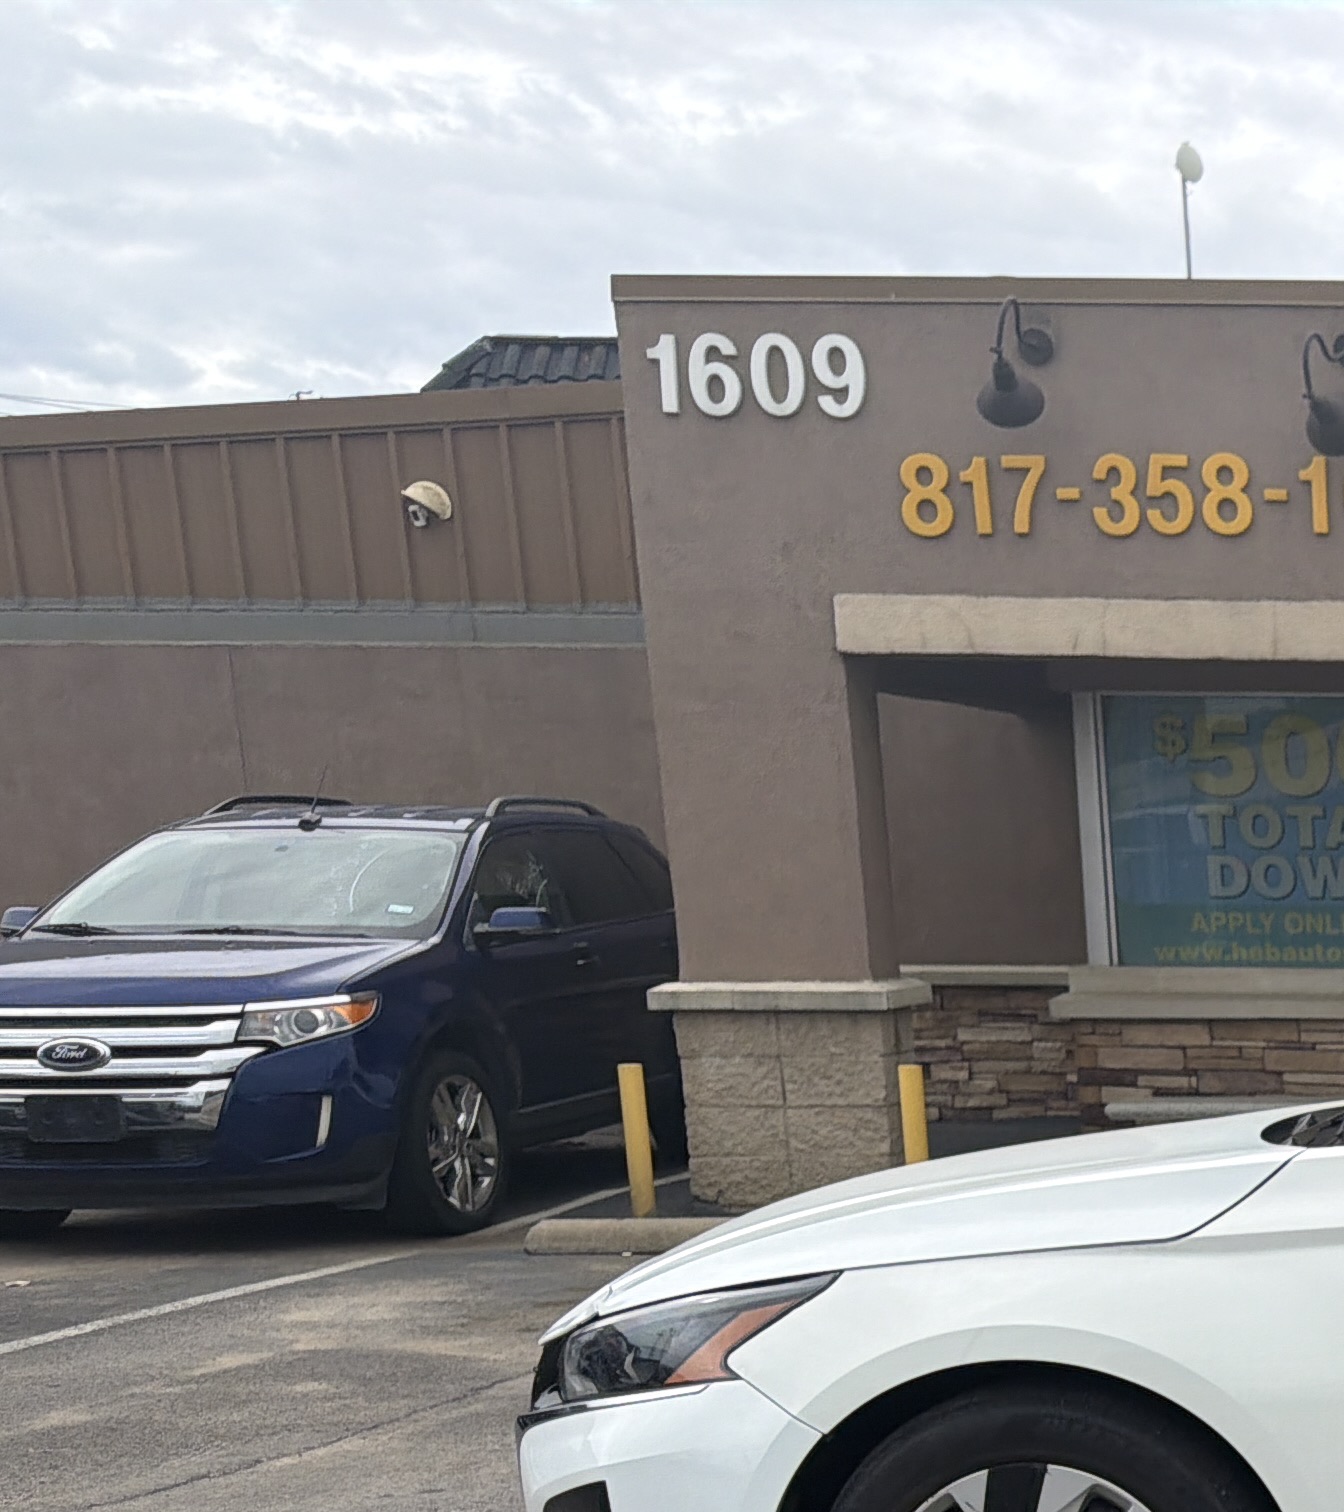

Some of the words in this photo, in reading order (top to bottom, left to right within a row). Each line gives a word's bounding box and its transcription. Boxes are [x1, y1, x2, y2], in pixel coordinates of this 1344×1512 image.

[645, 331, 867, 418] 1609
[1191, 912, 1274, 934] APPLY
[51, 1044, 88, 1060] Ford
